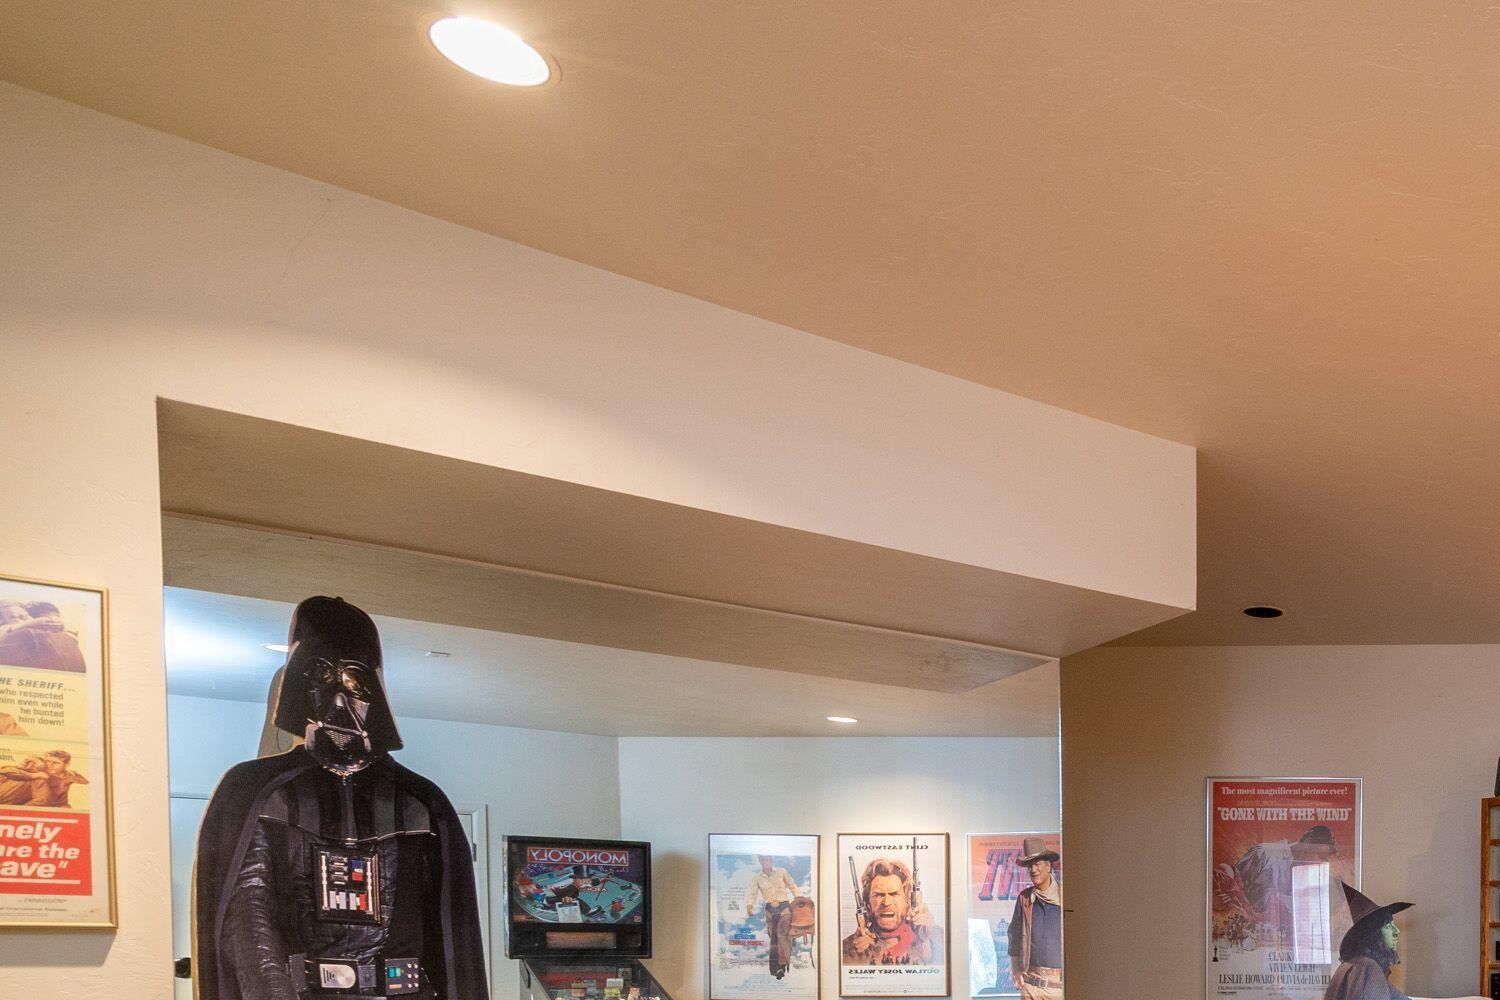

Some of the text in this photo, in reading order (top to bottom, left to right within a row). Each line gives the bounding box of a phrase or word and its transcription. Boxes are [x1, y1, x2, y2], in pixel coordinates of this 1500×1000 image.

[19, 689, 64, 701] respected
[1220, 786, 1236, 795] The
[1256, 786, 1301, 797] magnificent
[1302, 787, 1328, 797] picture
[1329, 786, 1348, 795] ever!
[1256, 807, 1288, 821] WITH
[1289, 807, 1315, 821] THE
[38, 842, 80, 860] the
[1219, 974, 1244, 985] LESLIE
[1245, 974, 1275, 985] HOWARD
